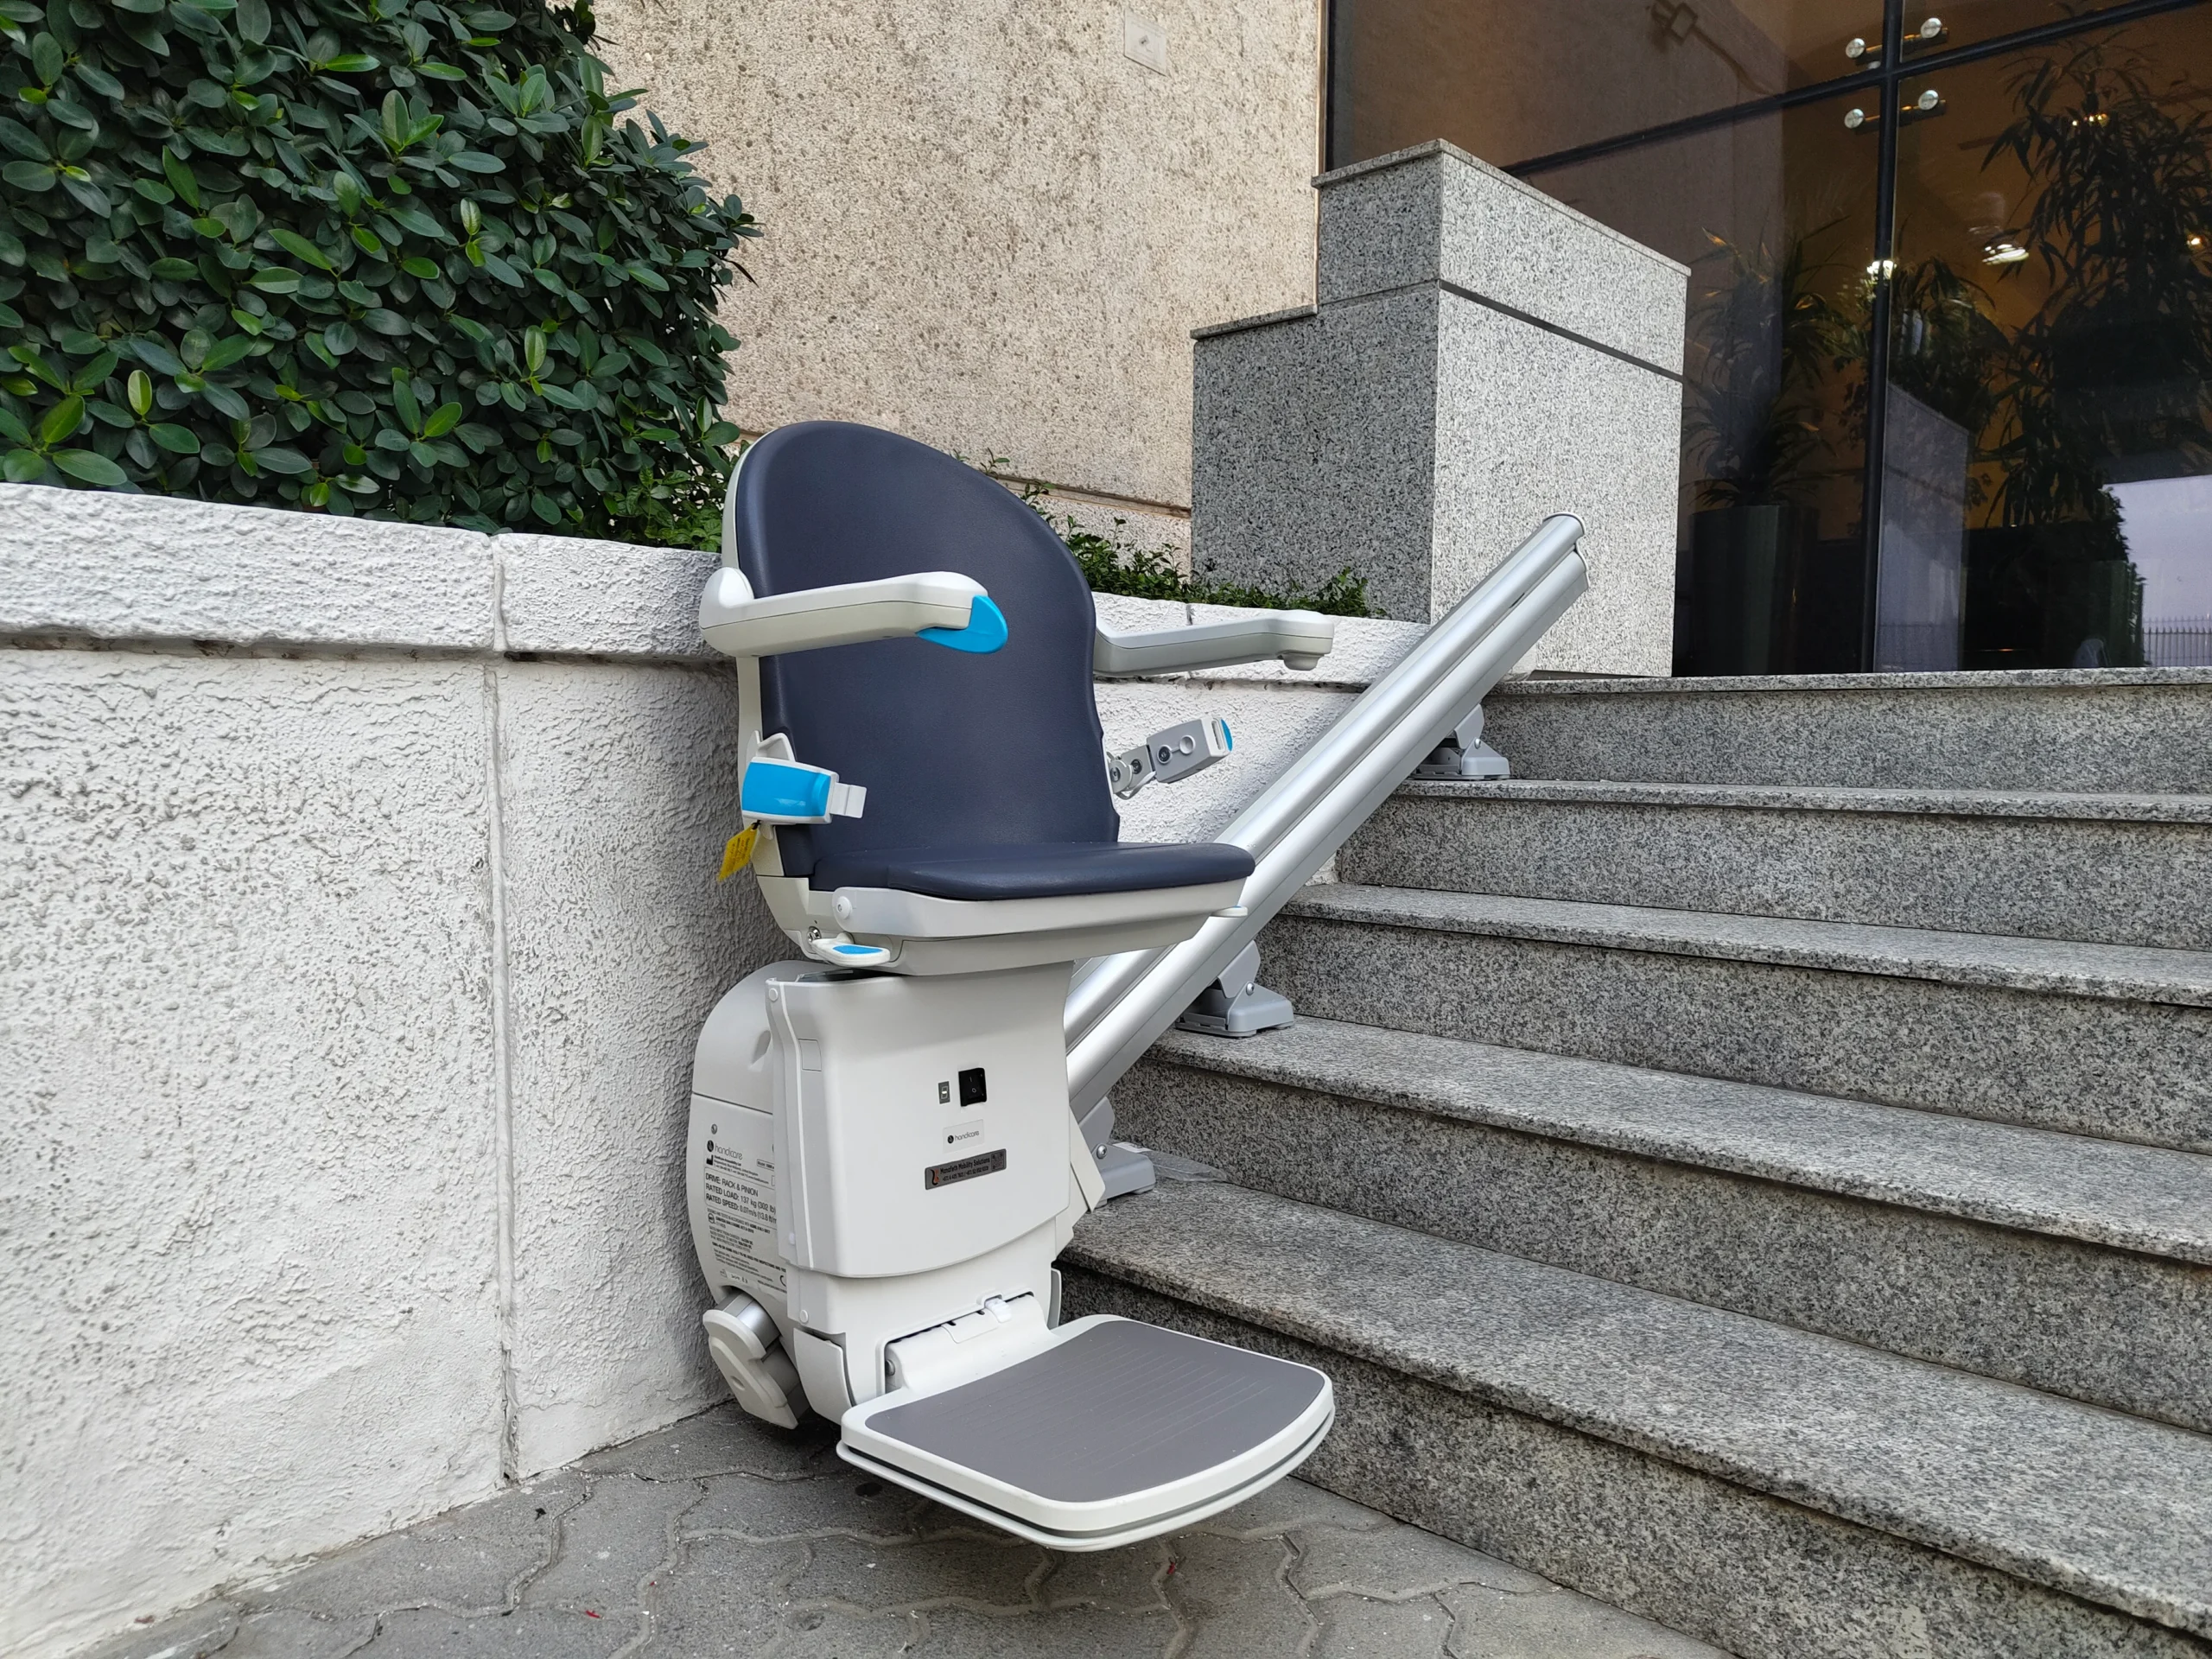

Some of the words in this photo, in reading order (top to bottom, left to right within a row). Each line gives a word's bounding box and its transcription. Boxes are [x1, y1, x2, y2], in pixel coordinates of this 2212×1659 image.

[955, 1130, 980, 1141] handicare
[715, 1143, 743, 1160] handicare
[958, 1161, 973, 1172] Mobility
[973, 1157, 990, 1166] Solutions
[705, 1173, 721, 1184] DRIVE:
[721, 1178, 735, 1190] RACK
[741, 1185, 759, 1197] PINION
[705, 1183, 722, 1195] RATED
[723, 1189, 740, 1201] LOAD:
[741, 1195, 749, 1204] 137
[750, 1198, 757, 1209] kg
[757, 1201, 769, 1211] (302
[705, 1193, 721, 1205] RATED
[722, 1198, 740, 1211] SPEED:
